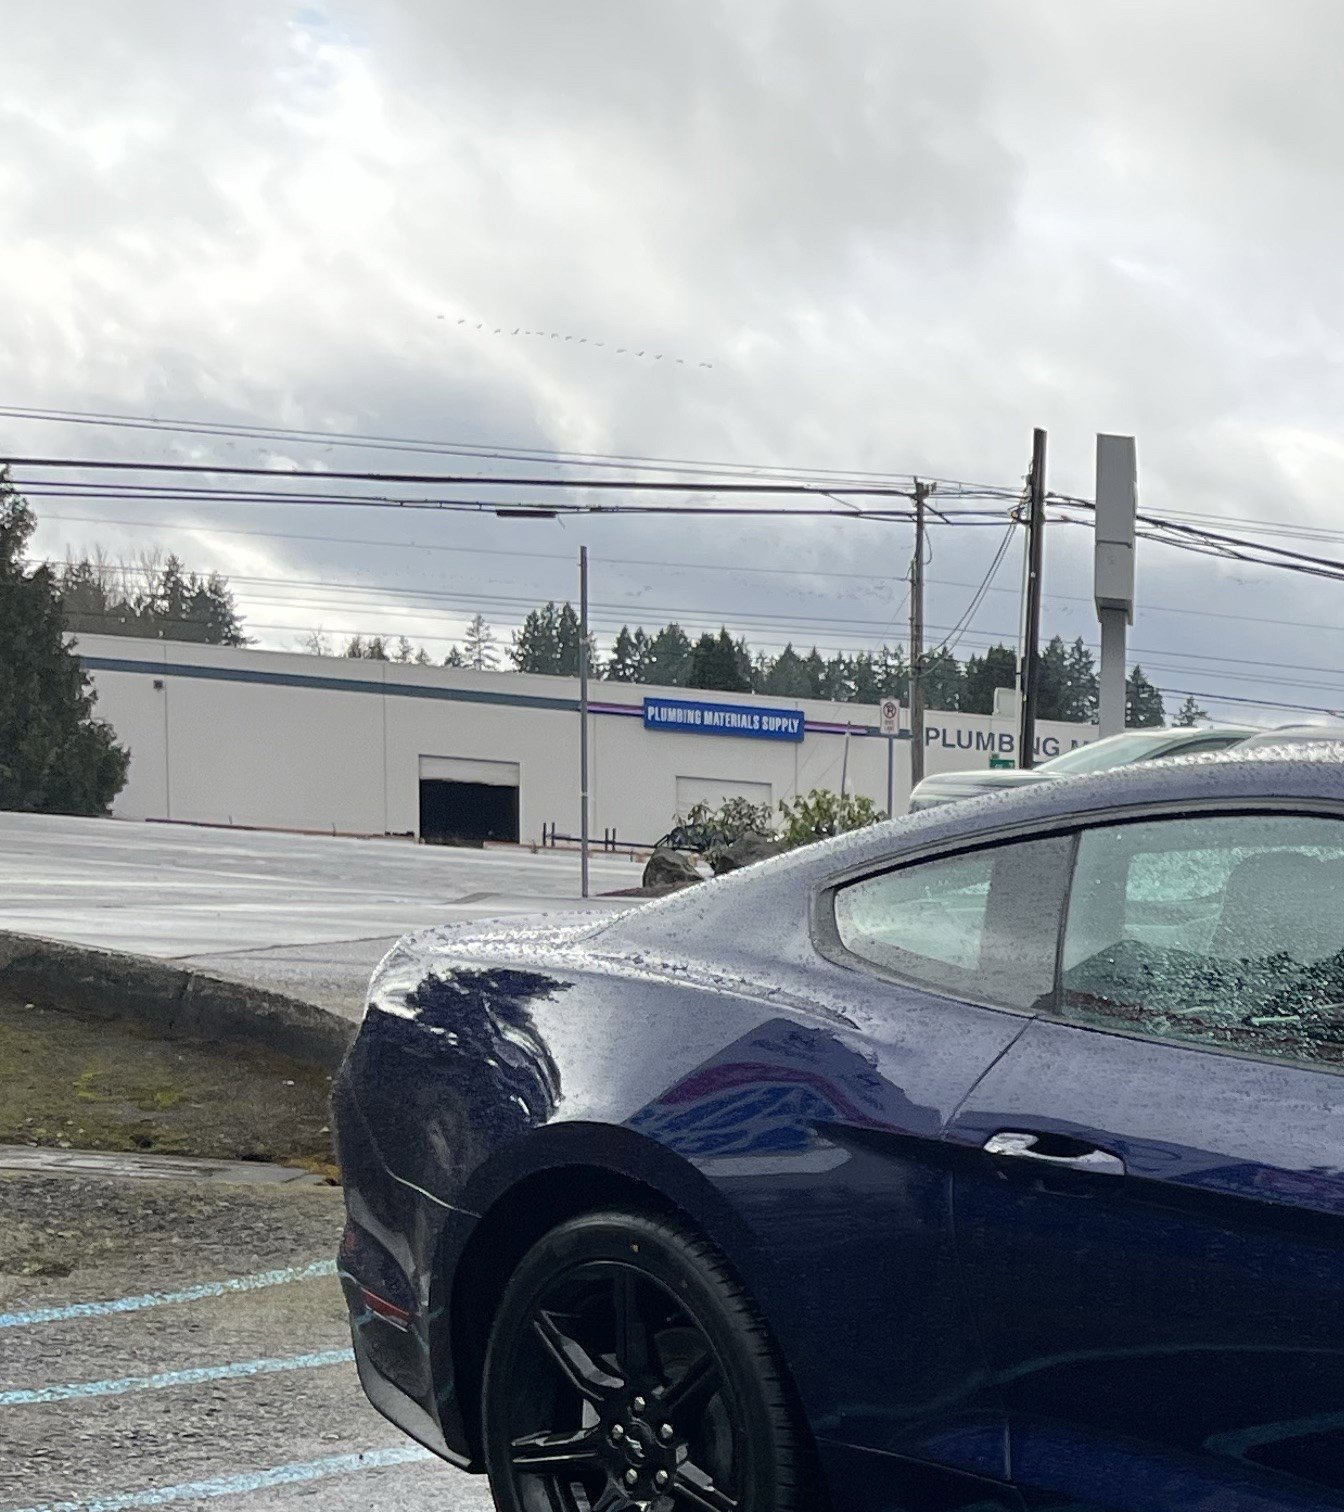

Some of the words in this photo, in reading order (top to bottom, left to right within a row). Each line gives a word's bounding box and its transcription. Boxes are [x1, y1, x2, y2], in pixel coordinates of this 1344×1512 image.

[647, 706, 702, 725] PLUMBING
[703, 711, 760, 730] MATERIALS
[761, 716, 800, 733] SUPPLY
[925, 727, 1060, 757] PLUMBG
